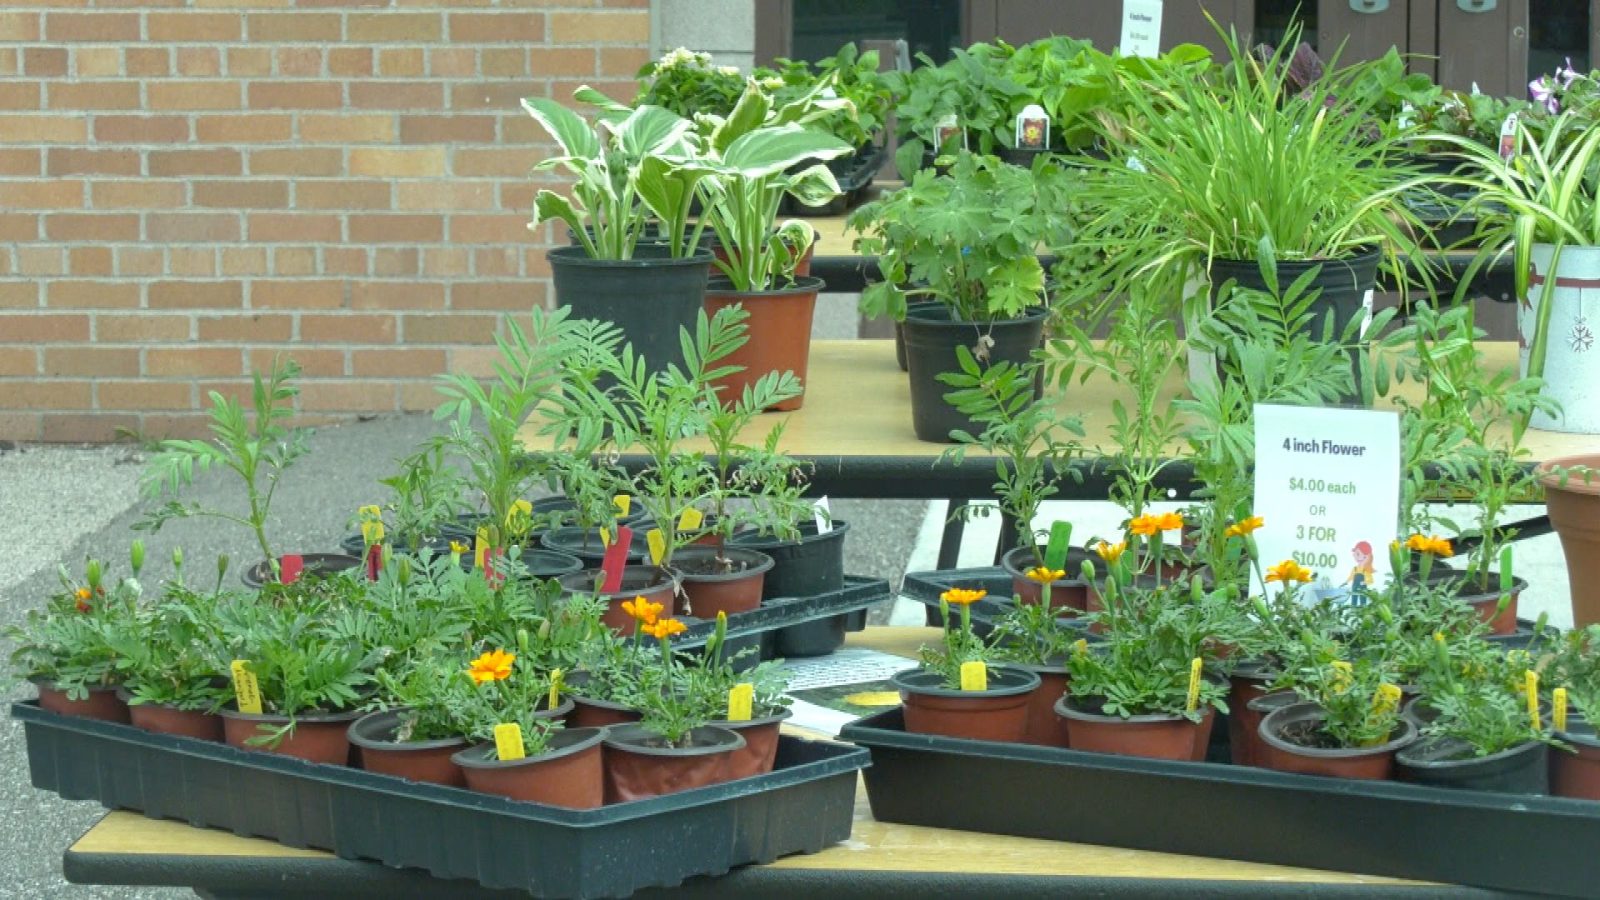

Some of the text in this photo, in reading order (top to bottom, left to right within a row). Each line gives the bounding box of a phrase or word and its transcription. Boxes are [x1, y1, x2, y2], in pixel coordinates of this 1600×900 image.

[1283, 438, 1366, 456] 4 inch Flower
[1289, 477, 1356, 494] $4.00 each
[1309, 505, 1326, 516] OR
[1296, 525, 1336, 542] 3 FOR
[1292, 550, 1337, 568] $10.00
